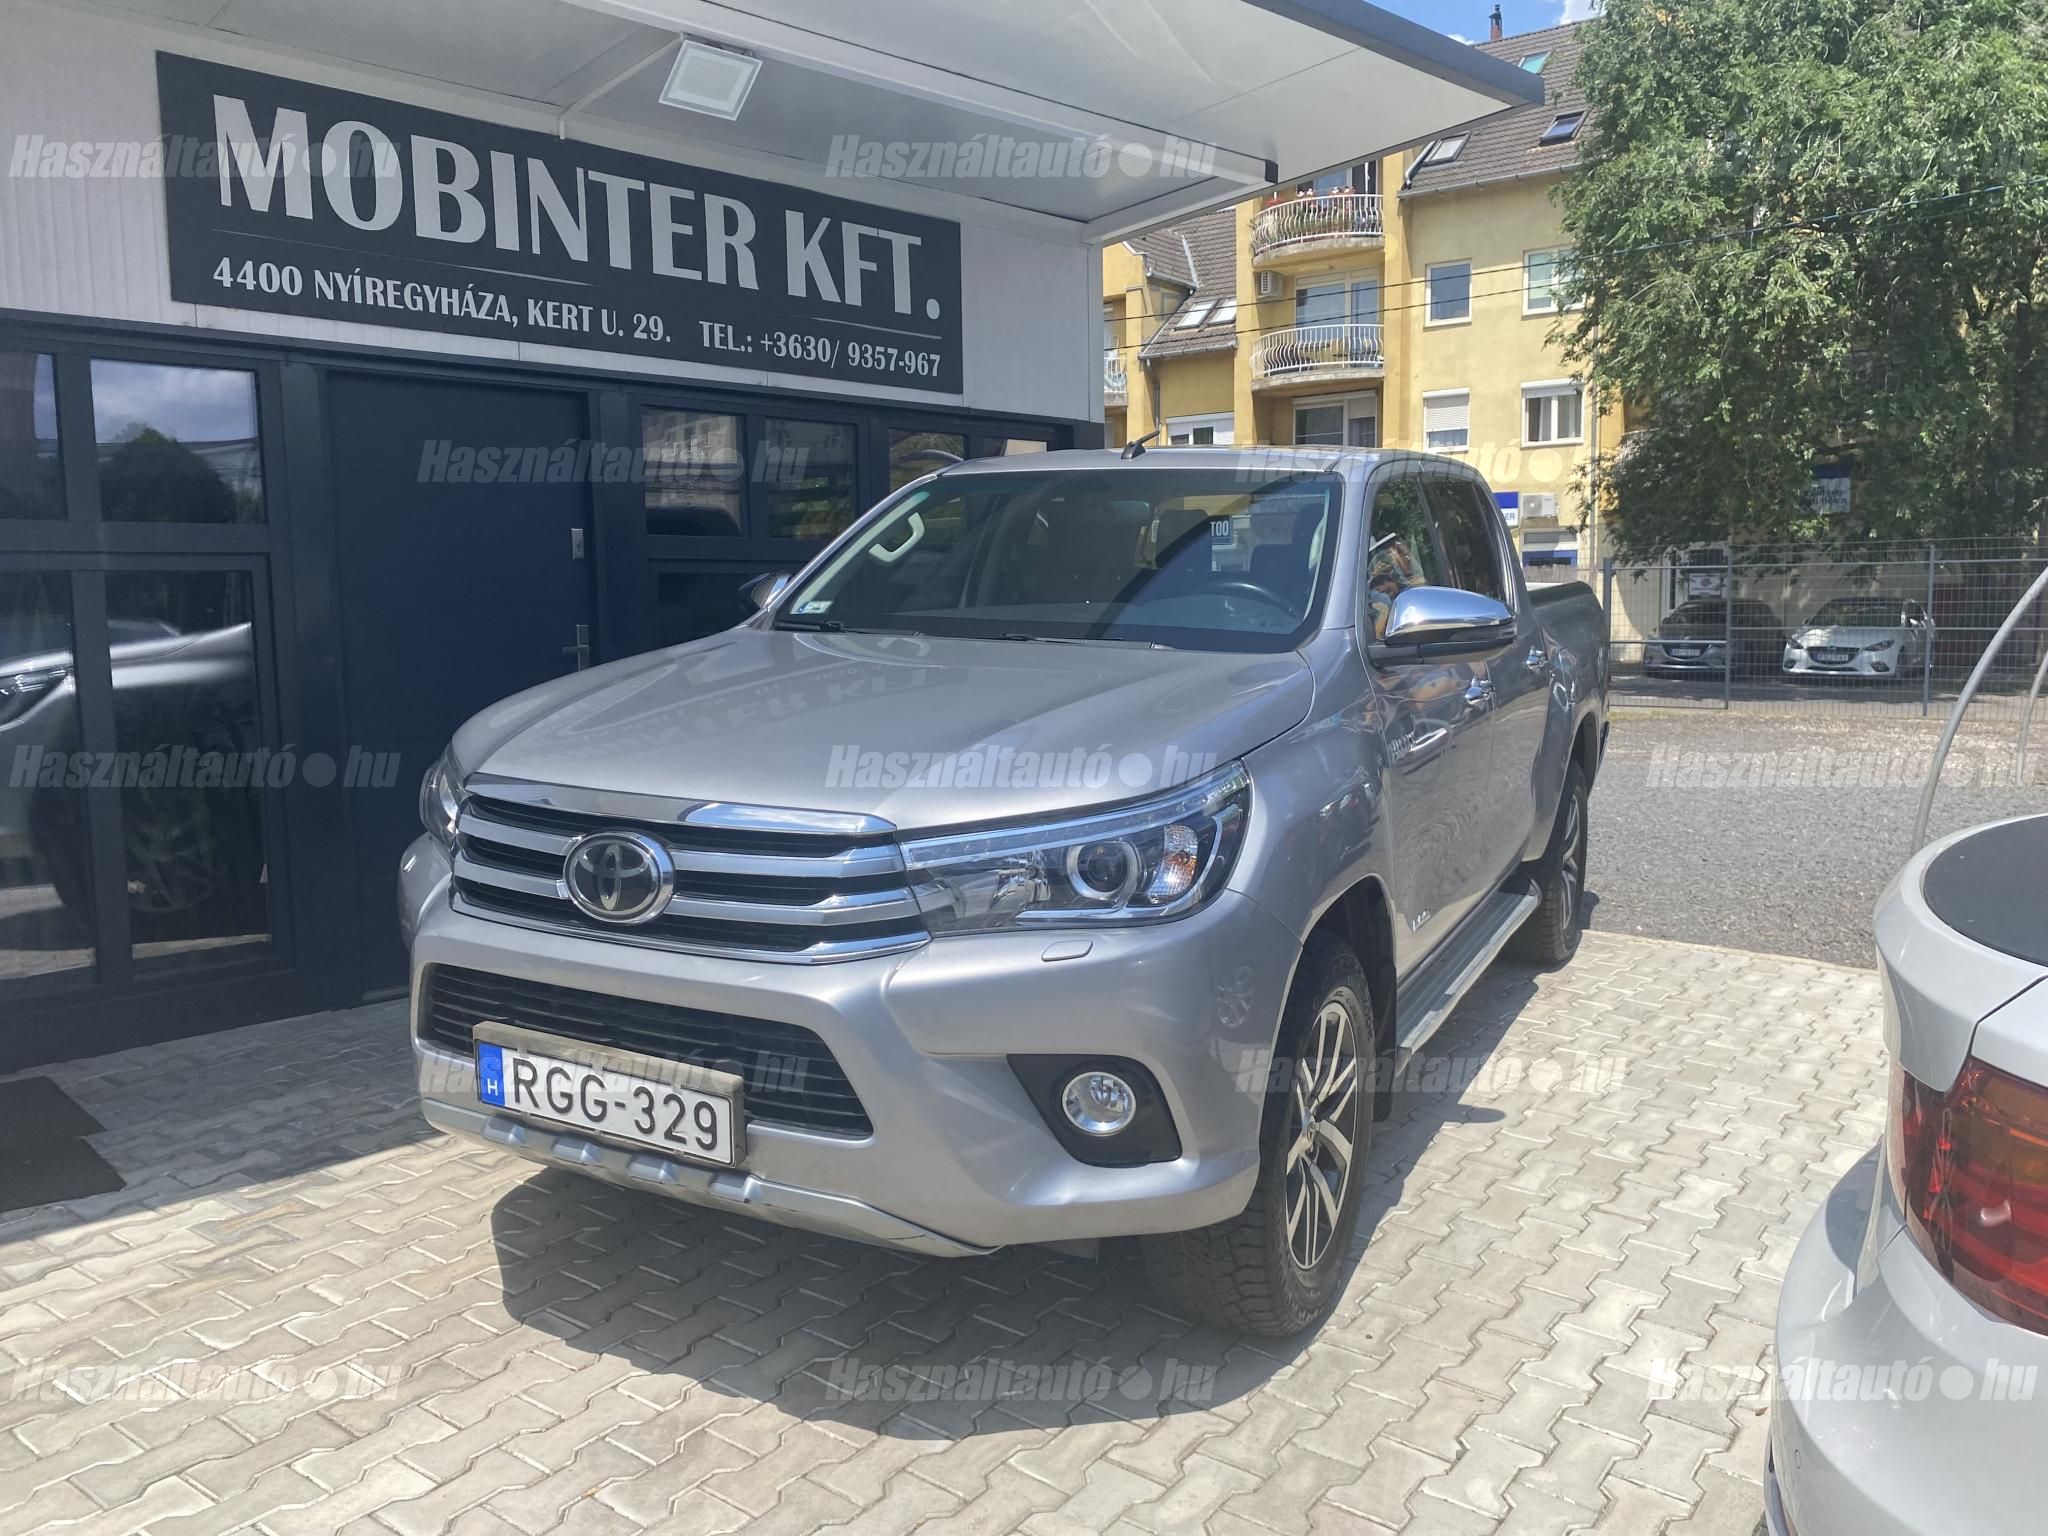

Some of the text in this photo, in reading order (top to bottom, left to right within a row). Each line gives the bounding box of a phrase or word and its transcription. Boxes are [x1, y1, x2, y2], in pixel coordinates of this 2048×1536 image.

[213, 94, 940, 320] MOBINTER KFT.
[212, 256, 941, 377] 4400 NYÍREGYHÁZA, KERT U. 29. TEL.: +3630/ 9357-967
[487, 1057, 718, 1150] H RGG-329
